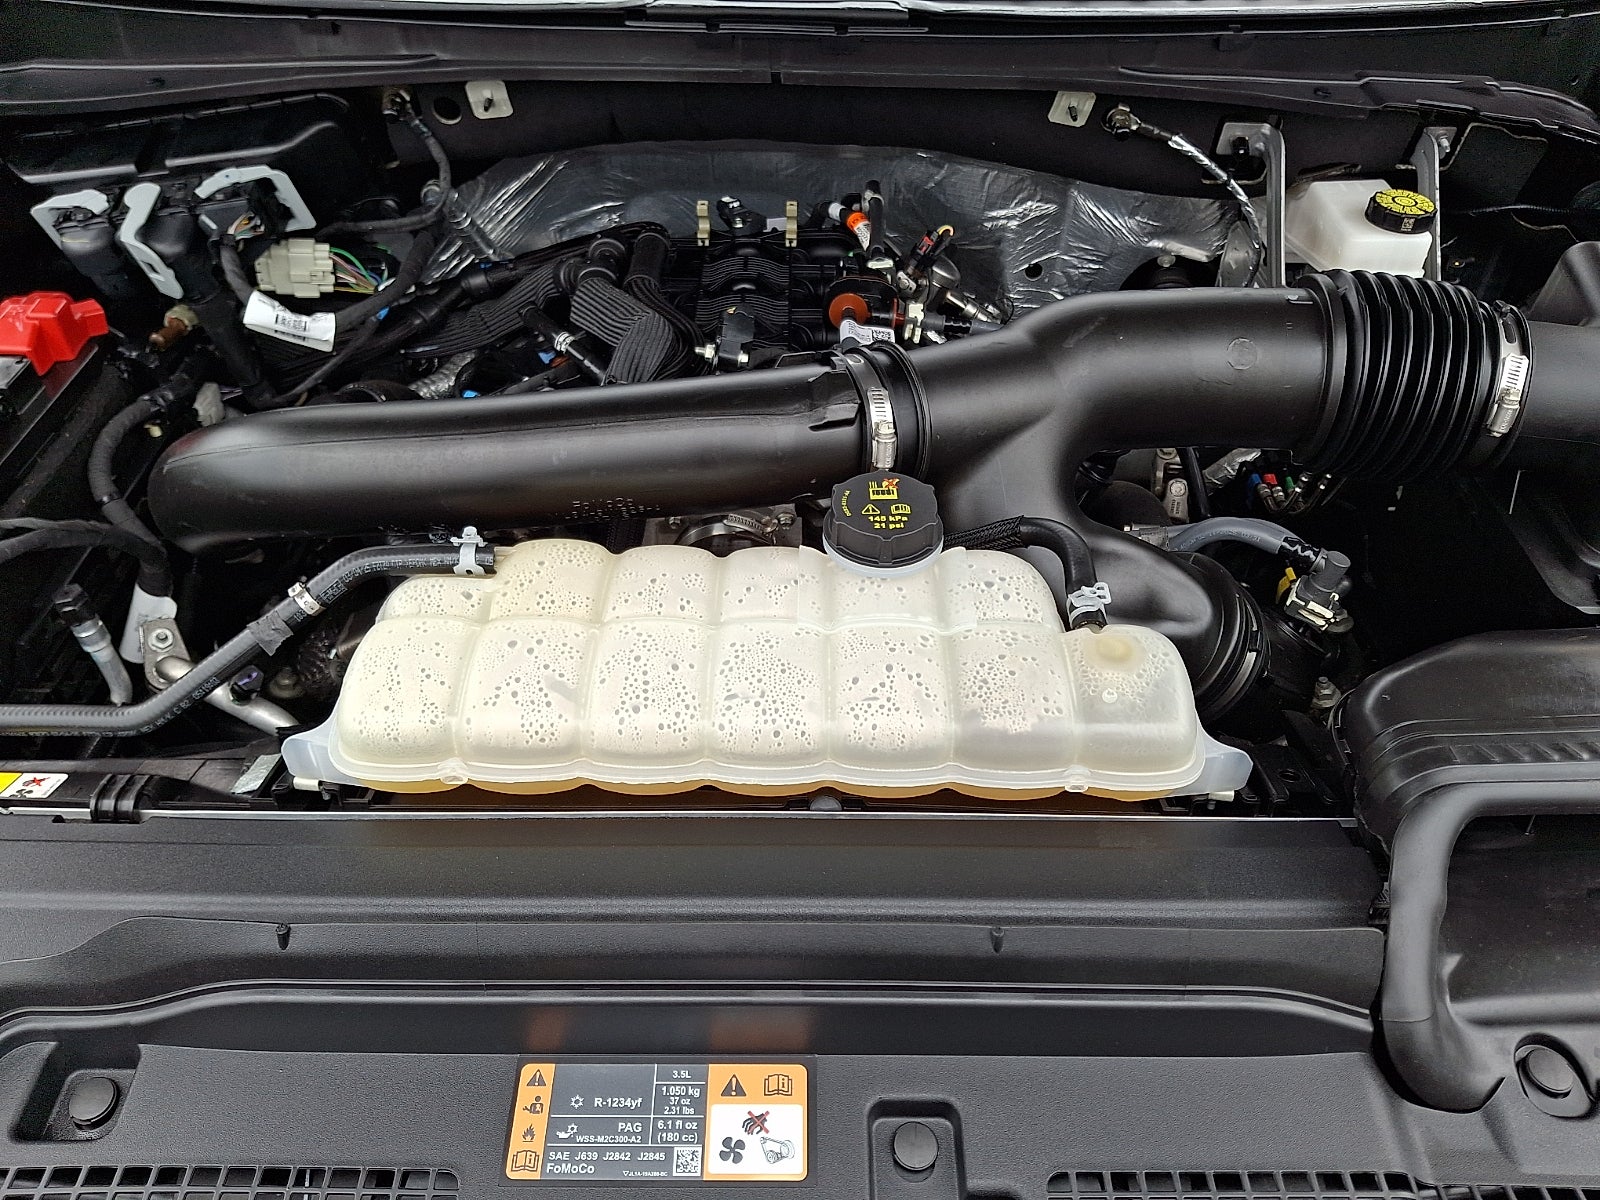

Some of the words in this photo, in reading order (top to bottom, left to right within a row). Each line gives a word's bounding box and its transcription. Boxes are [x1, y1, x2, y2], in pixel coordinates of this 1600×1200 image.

[672, 1070, 692, 1078] 3.5L
[662, 1086, 686, 1096] 1.050
[688, 1086, 700, 1098] kg
[594, 1098, 642, 1110] R-1234yf
[670, 1097, 680, 1105] 37
[664, 1106, 679, 1114] 2.31
[681, 1106, 694, 1114] lbs
[618, 1122, 642, 1132] PAG
[658, 1121, 672, 1130] 6.1
[674, 1120, 682, 1130] fl
[576, 1135, 642, 1144] WSS-M2C300-A2
[658, 1132, 680, 1144] (180
[682, 1132, 698, 1144] cc)
[548, 1152, 570, 1161] SAE
[574, 1152, 598, 1161] J639
[602, 1152, 631, 1161] J2842
[637, 1152, 666, 1161] J2845
[546, 1164, 594, 1174] FoMoCo
